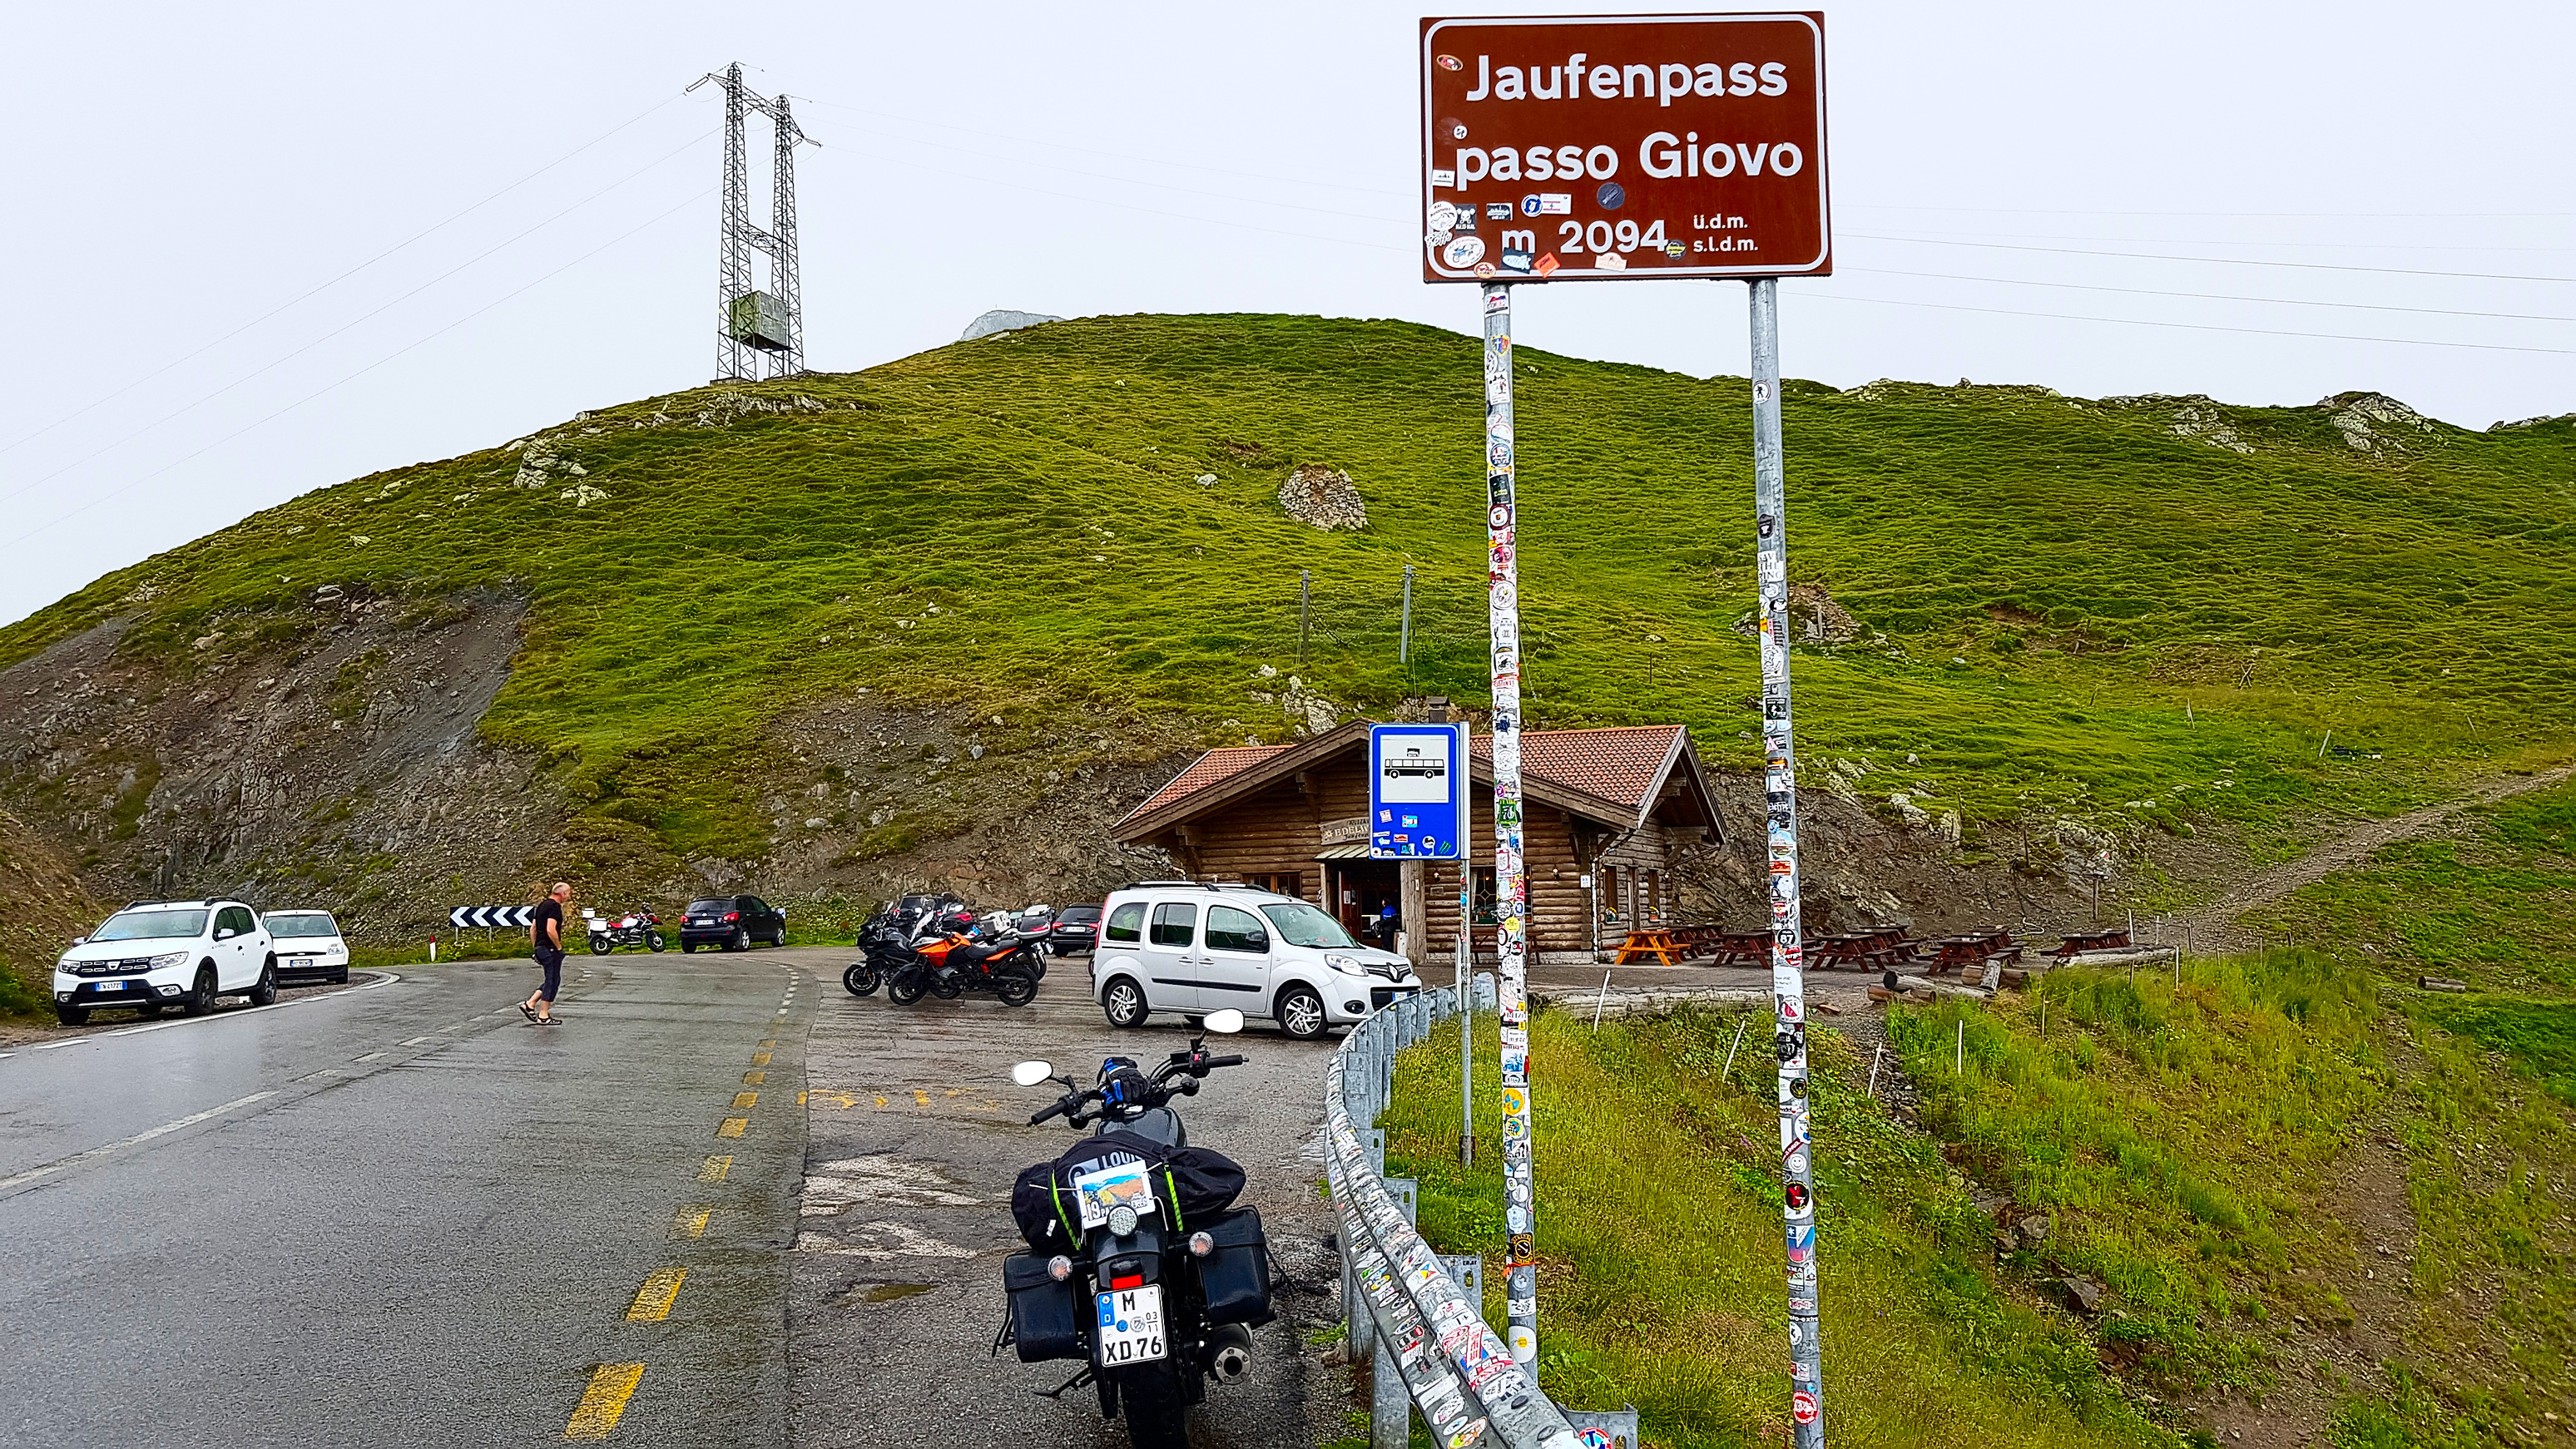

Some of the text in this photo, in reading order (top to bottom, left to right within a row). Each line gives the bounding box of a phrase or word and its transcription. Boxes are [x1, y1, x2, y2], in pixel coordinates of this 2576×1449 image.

[1466, 53, 1788, 106] Jaufenpass
[1456, 131, 1803, 191] passo Giovo
[1693, 214, 1748, 230] ü.d.m.
[1502, 229, 1536, 254] m
[1558, 219, 1667, 253] 2094
[1693, 237, 1758, 252] s.l.d.m.
[1122, 1293, 1135, 1312] M
[1104, 1313, 1112, 1324] D
[1146, 1312, 1157, 1321] 03
[1105, 1336, 1162, 1363] XD 76
